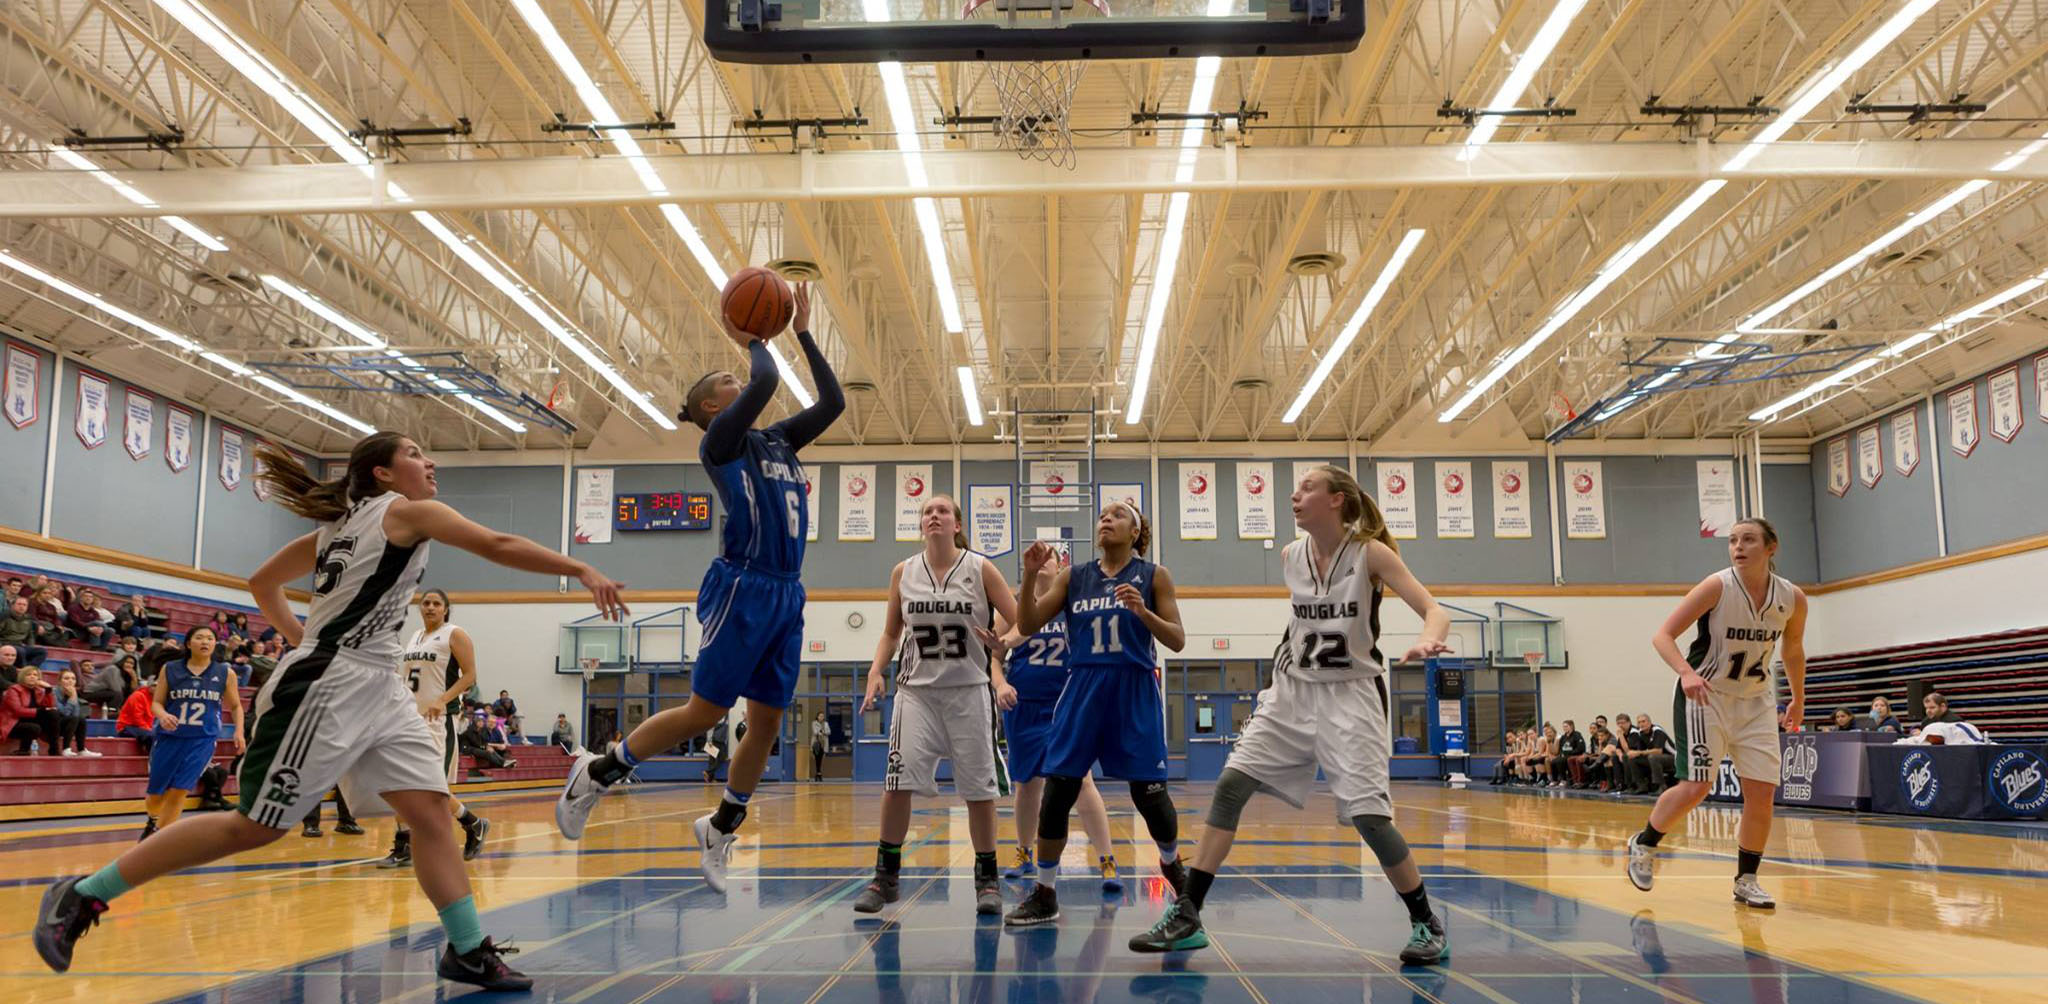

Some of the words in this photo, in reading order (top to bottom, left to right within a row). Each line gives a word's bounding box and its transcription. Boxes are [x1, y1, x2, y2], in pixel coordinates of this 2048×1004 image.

[619, 505, 638, 521] 51
[650, 493, 683, 509] 3:43
[785, 490, 800, 539] 6
[907, 601, 973, 615] DOUGLAS
[1072, 597, 1128, 614] CAPILA
[912, 625, 969, 659] 23
[1091, 614, 1122, 654] 11
[1726, 627, 1782, 642] DOUGLA
[1028, 637, 1065, 666] 22
[1299, 631, 1352, 670] 12
[178, 702, 206, 726] 12
[1694, 758, 1712, 767] DC
[1782, 744, 1818, 782] CAP
[1993, 752, 2024, 778] CAPILANO
[1783, 783, 1812, 801] BLUES
[1906, 761, 1931, 800] Blues
[2000, 760, 2041, 804] Blues
[264, 788, 300, 806] DC
